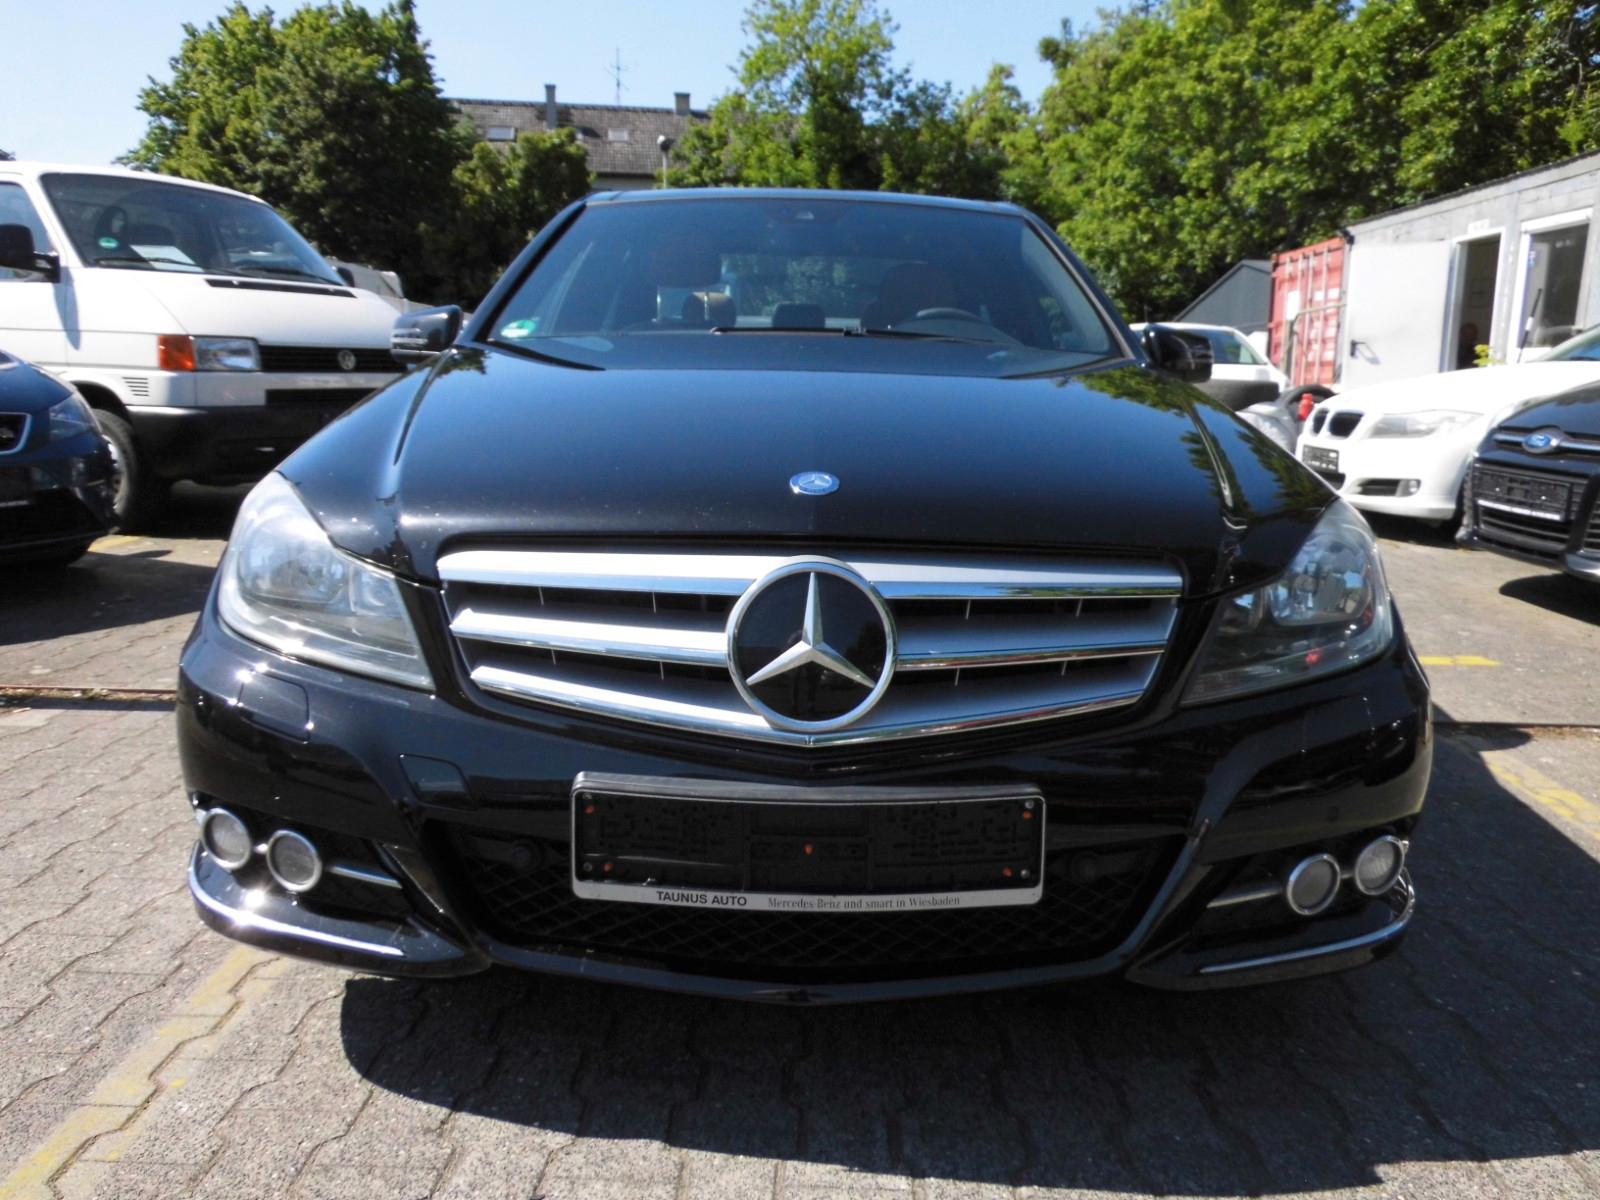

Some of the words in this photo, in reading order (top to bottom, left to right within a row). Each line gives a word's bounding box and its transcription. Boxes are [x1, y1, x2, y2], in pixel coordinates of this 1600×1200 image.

[656, 890, 708, 905] TAUNUS
[711, 895, 748, 906] AUTO
[843, 898, 863, 909] und
[865, 899, 893, 909] smart
[896, 898, 906, 908] in
[908, 895, 960, 906] Wiesbaden
